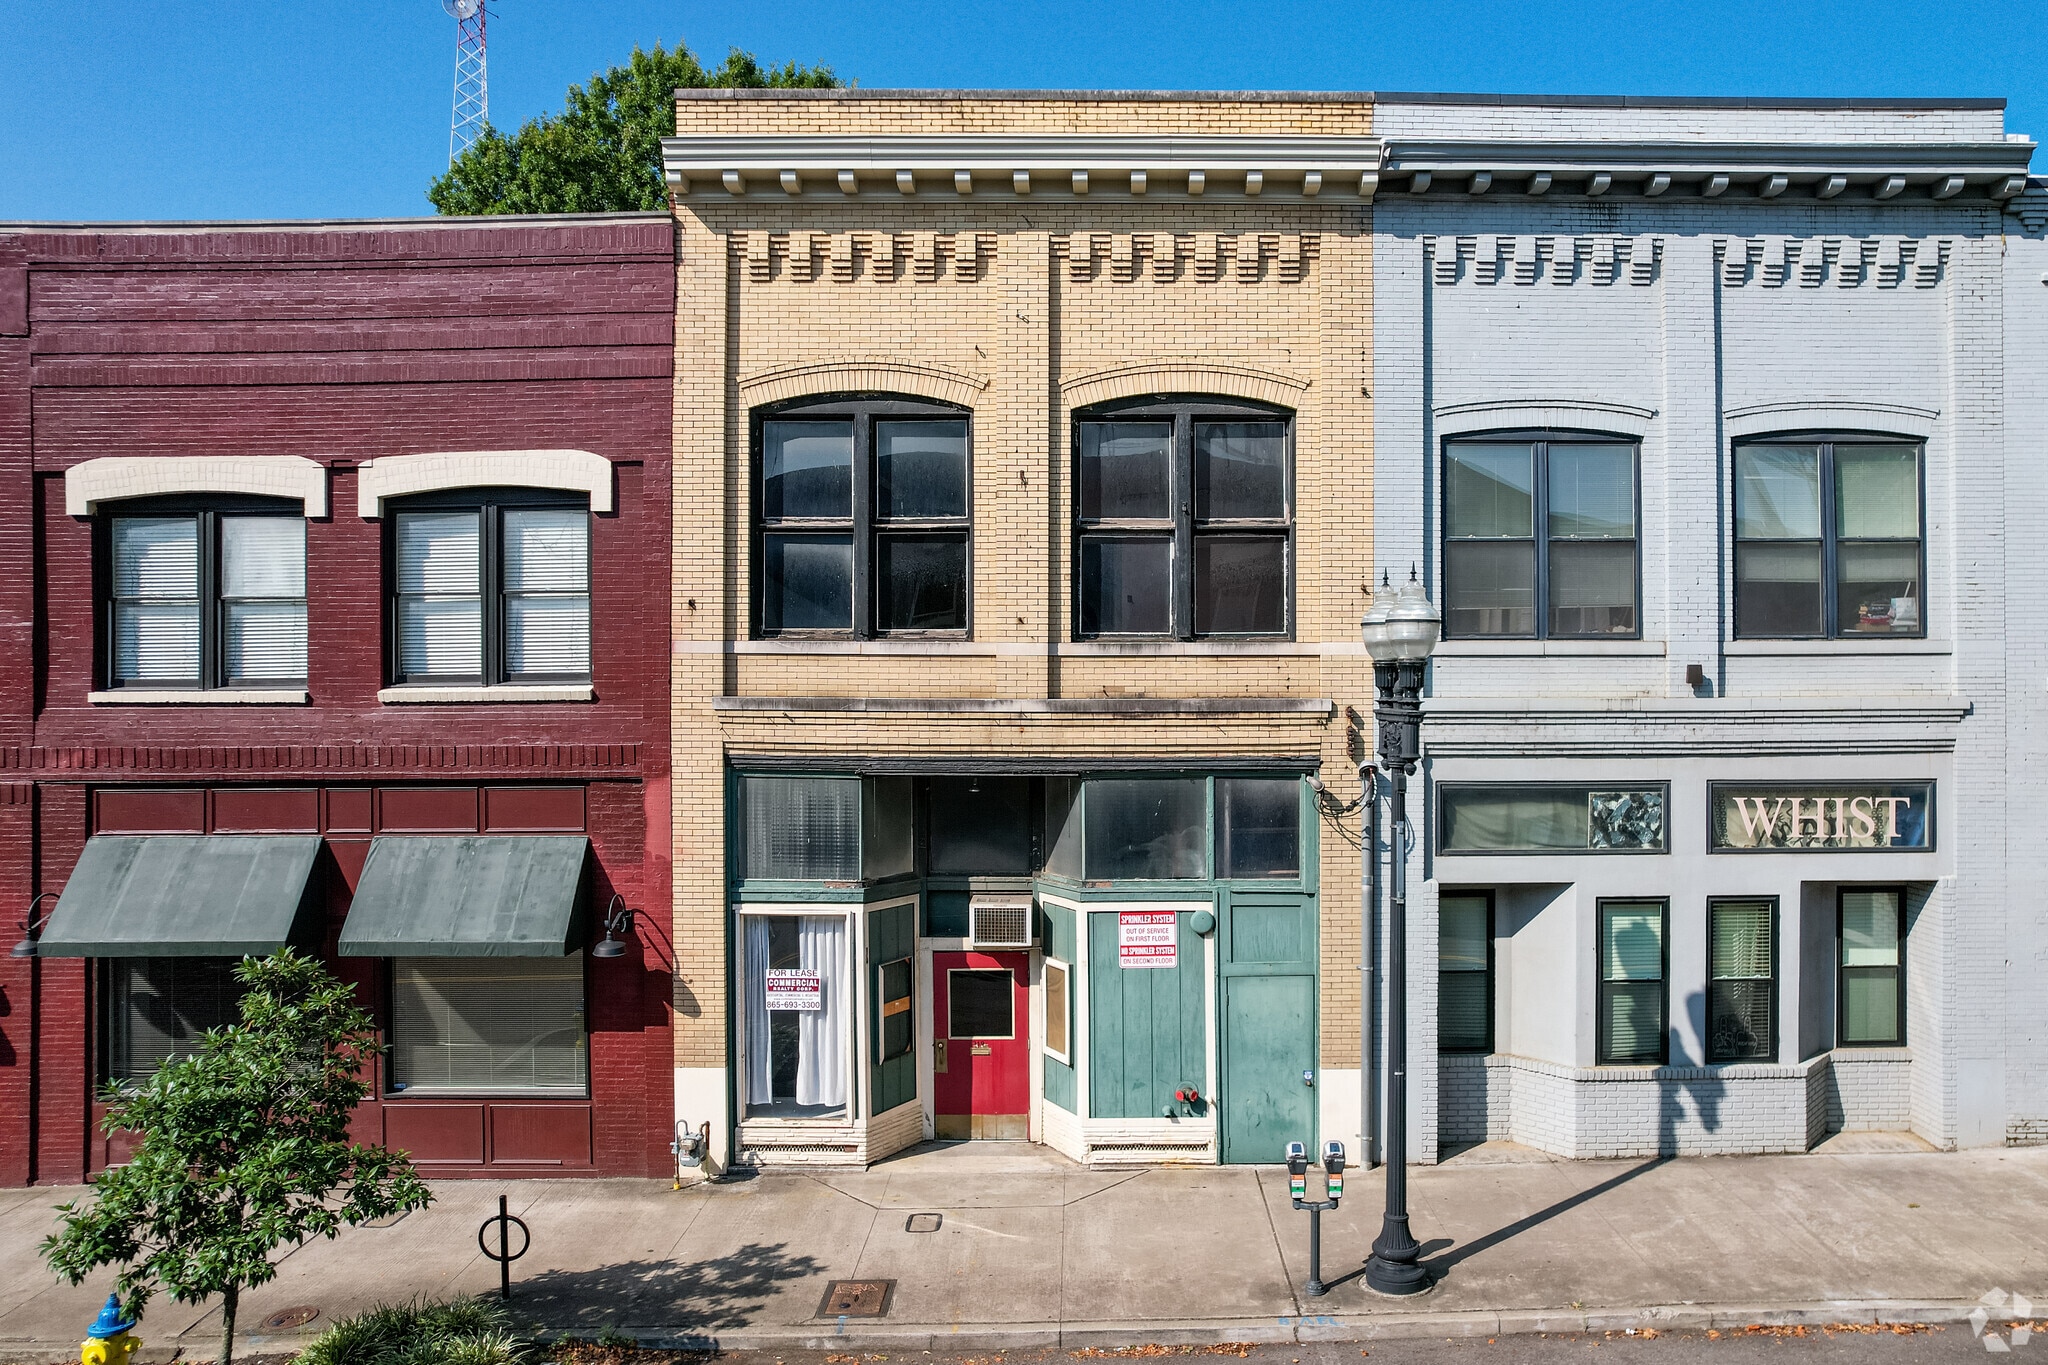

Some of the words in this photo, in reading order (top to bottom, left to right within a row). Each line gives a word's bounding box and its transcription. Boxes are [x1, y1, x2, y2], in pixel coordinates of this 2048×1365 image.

[1732, 796, 1910, 838] WHIST
[1121, 915, 1151, 923] SPRINKLER
[1152, 914, 1174, 923] SYSTEM
[1155, 946, 1174, 954] SYSTEM
